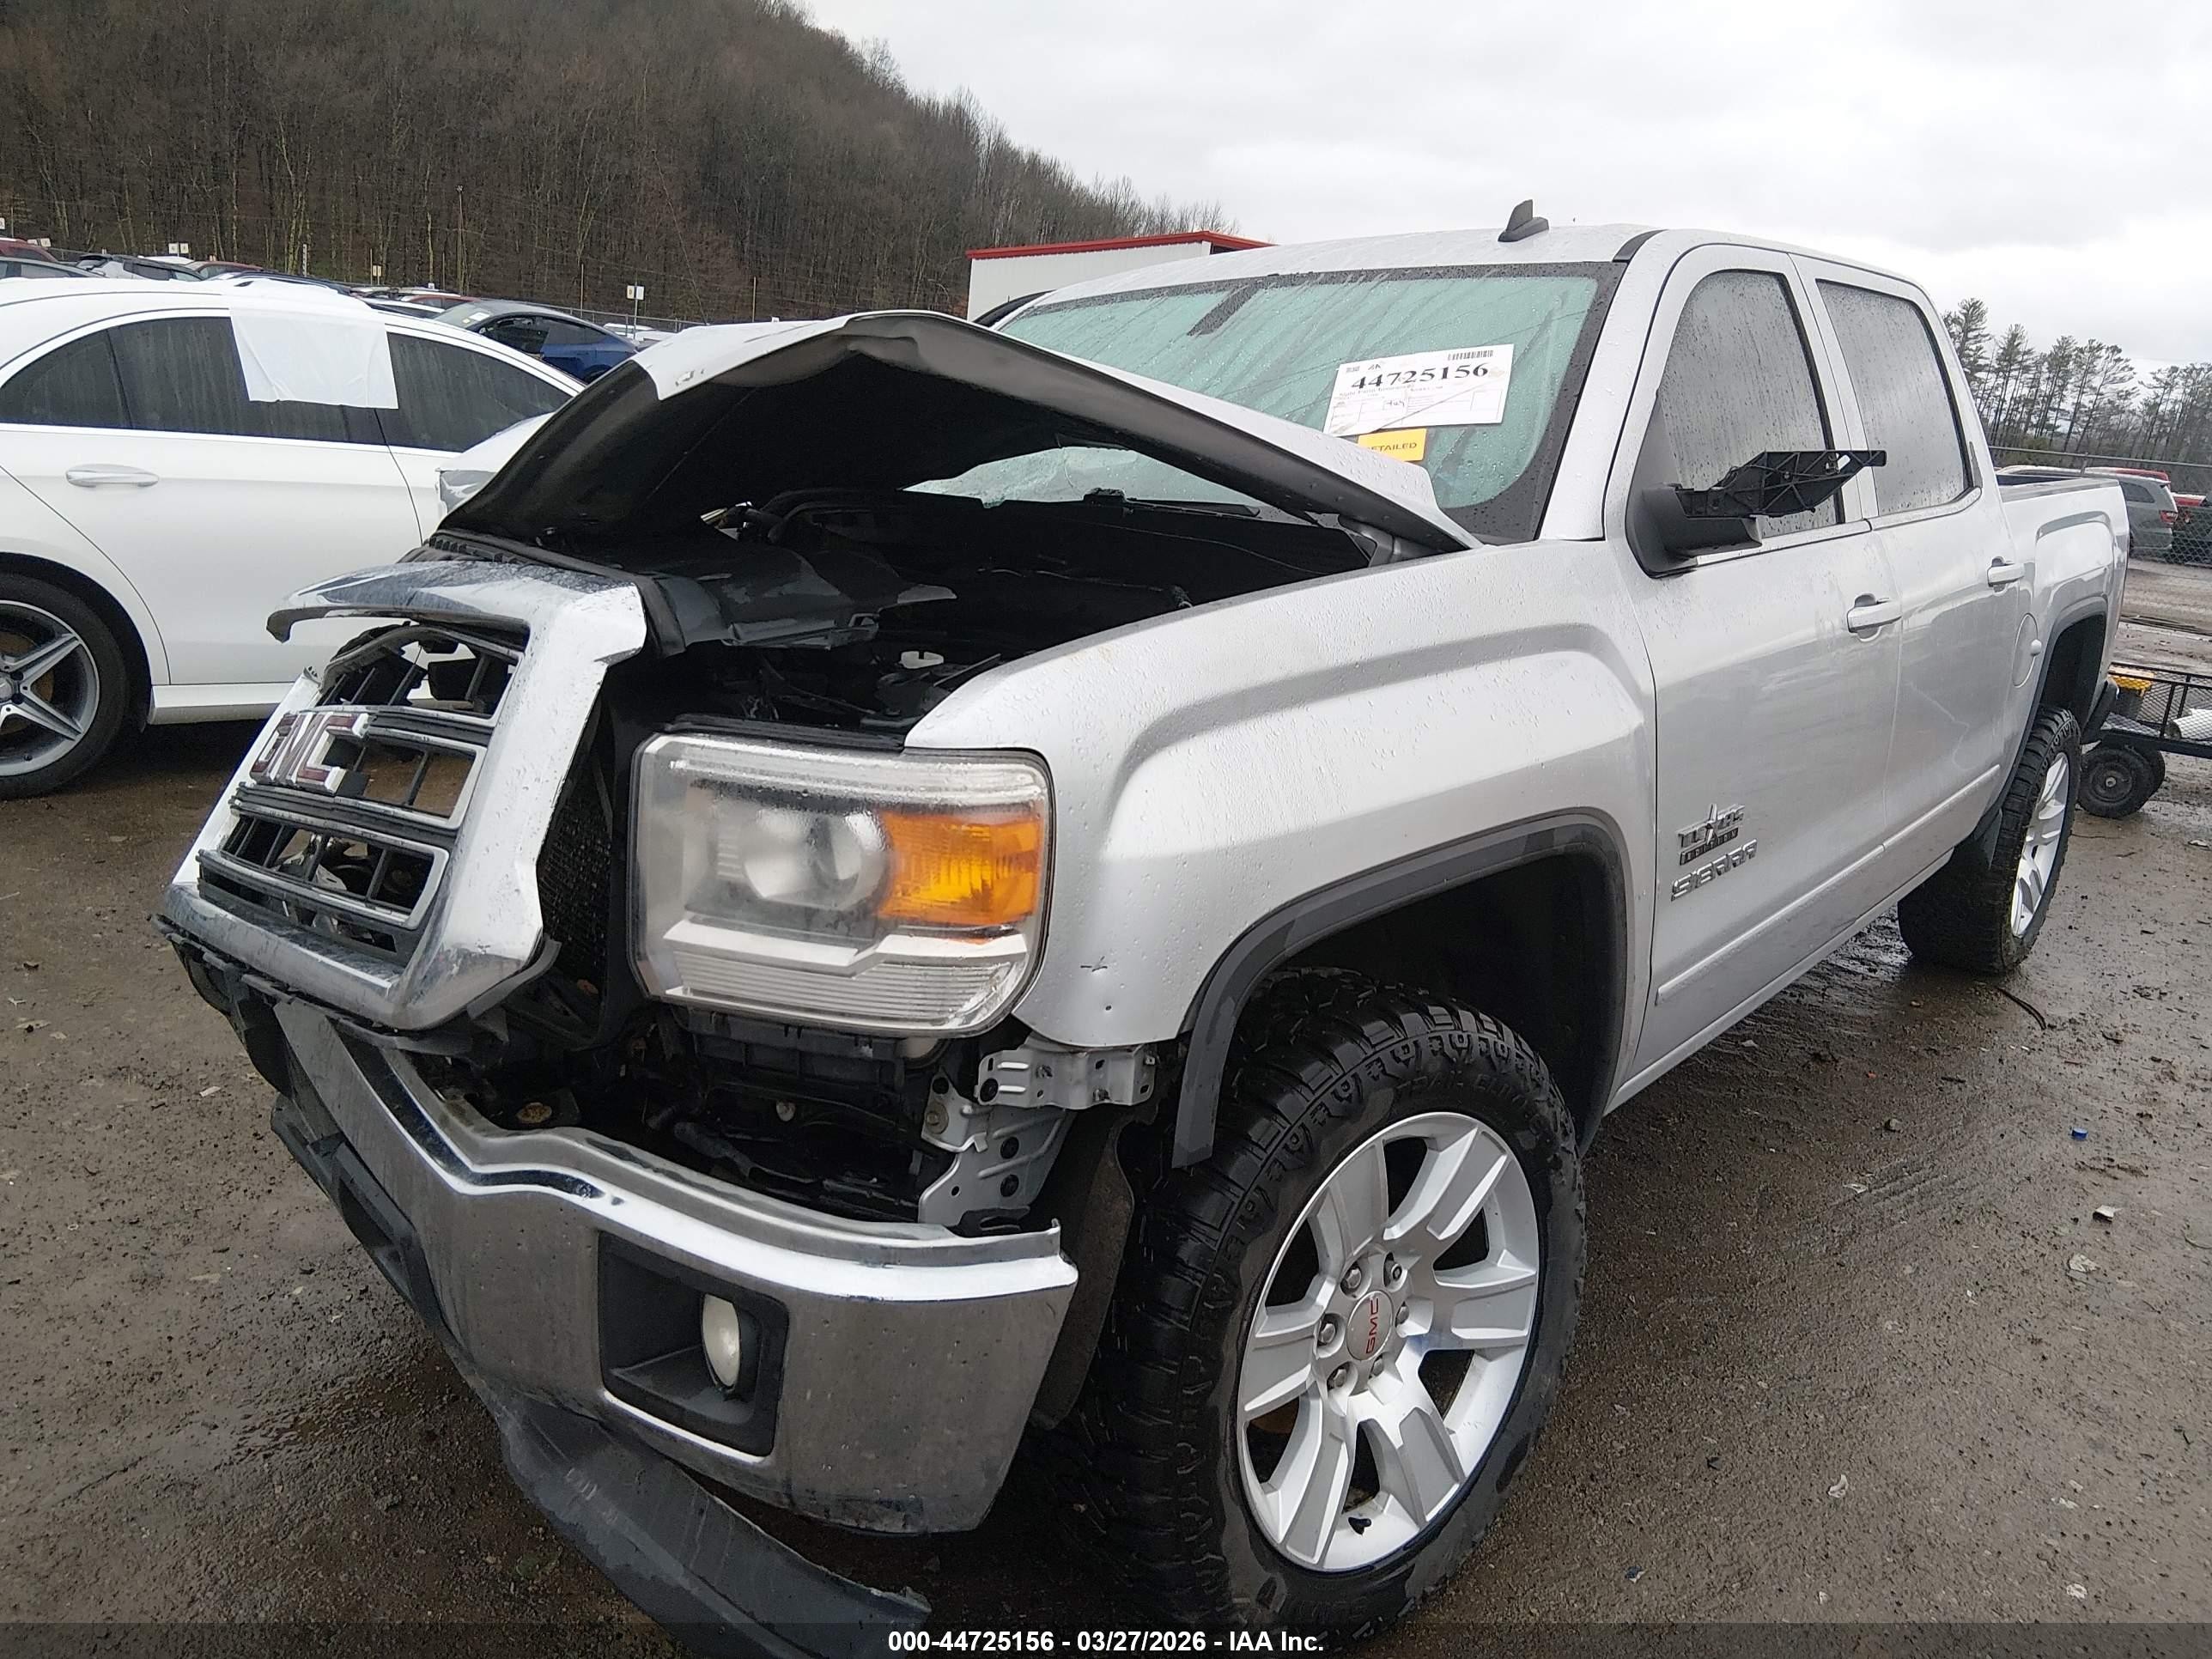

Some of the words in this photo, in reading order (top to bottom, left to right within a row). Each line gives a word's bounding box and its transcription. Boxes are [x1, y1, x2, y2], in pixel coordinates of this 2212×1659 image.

[1351, 362, 1488, 389] 44725156
[1671, 838, 1758, 902] SIERRA
[1365, 1297, 1379, 1354] GMC
